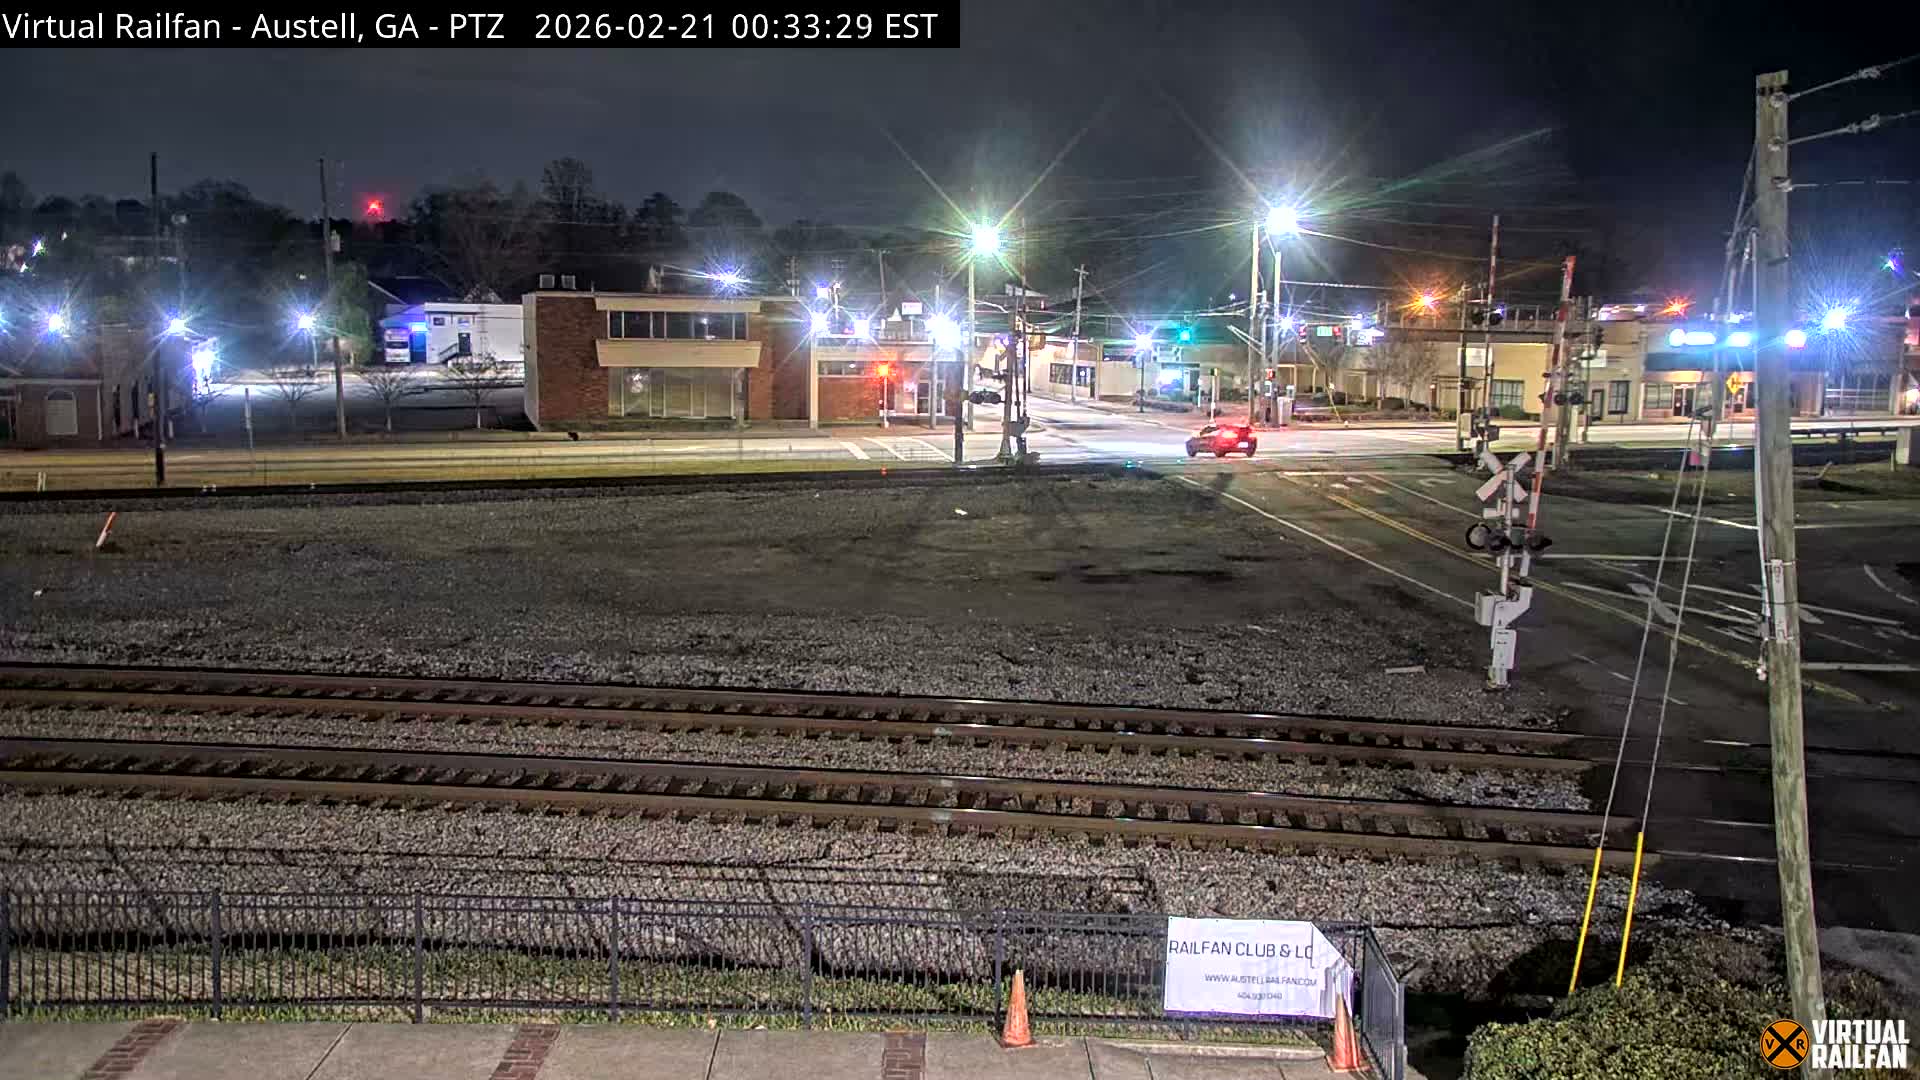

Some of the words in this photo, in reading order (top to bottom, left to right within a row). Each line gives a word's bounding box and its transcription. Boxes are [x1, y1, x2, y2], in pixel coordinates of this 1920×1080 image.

[1169, 940, 1231, 956] RAILFAN
[1235, 942, 1276, 958] CLUB
[1279, 943, 1292, 958] &
